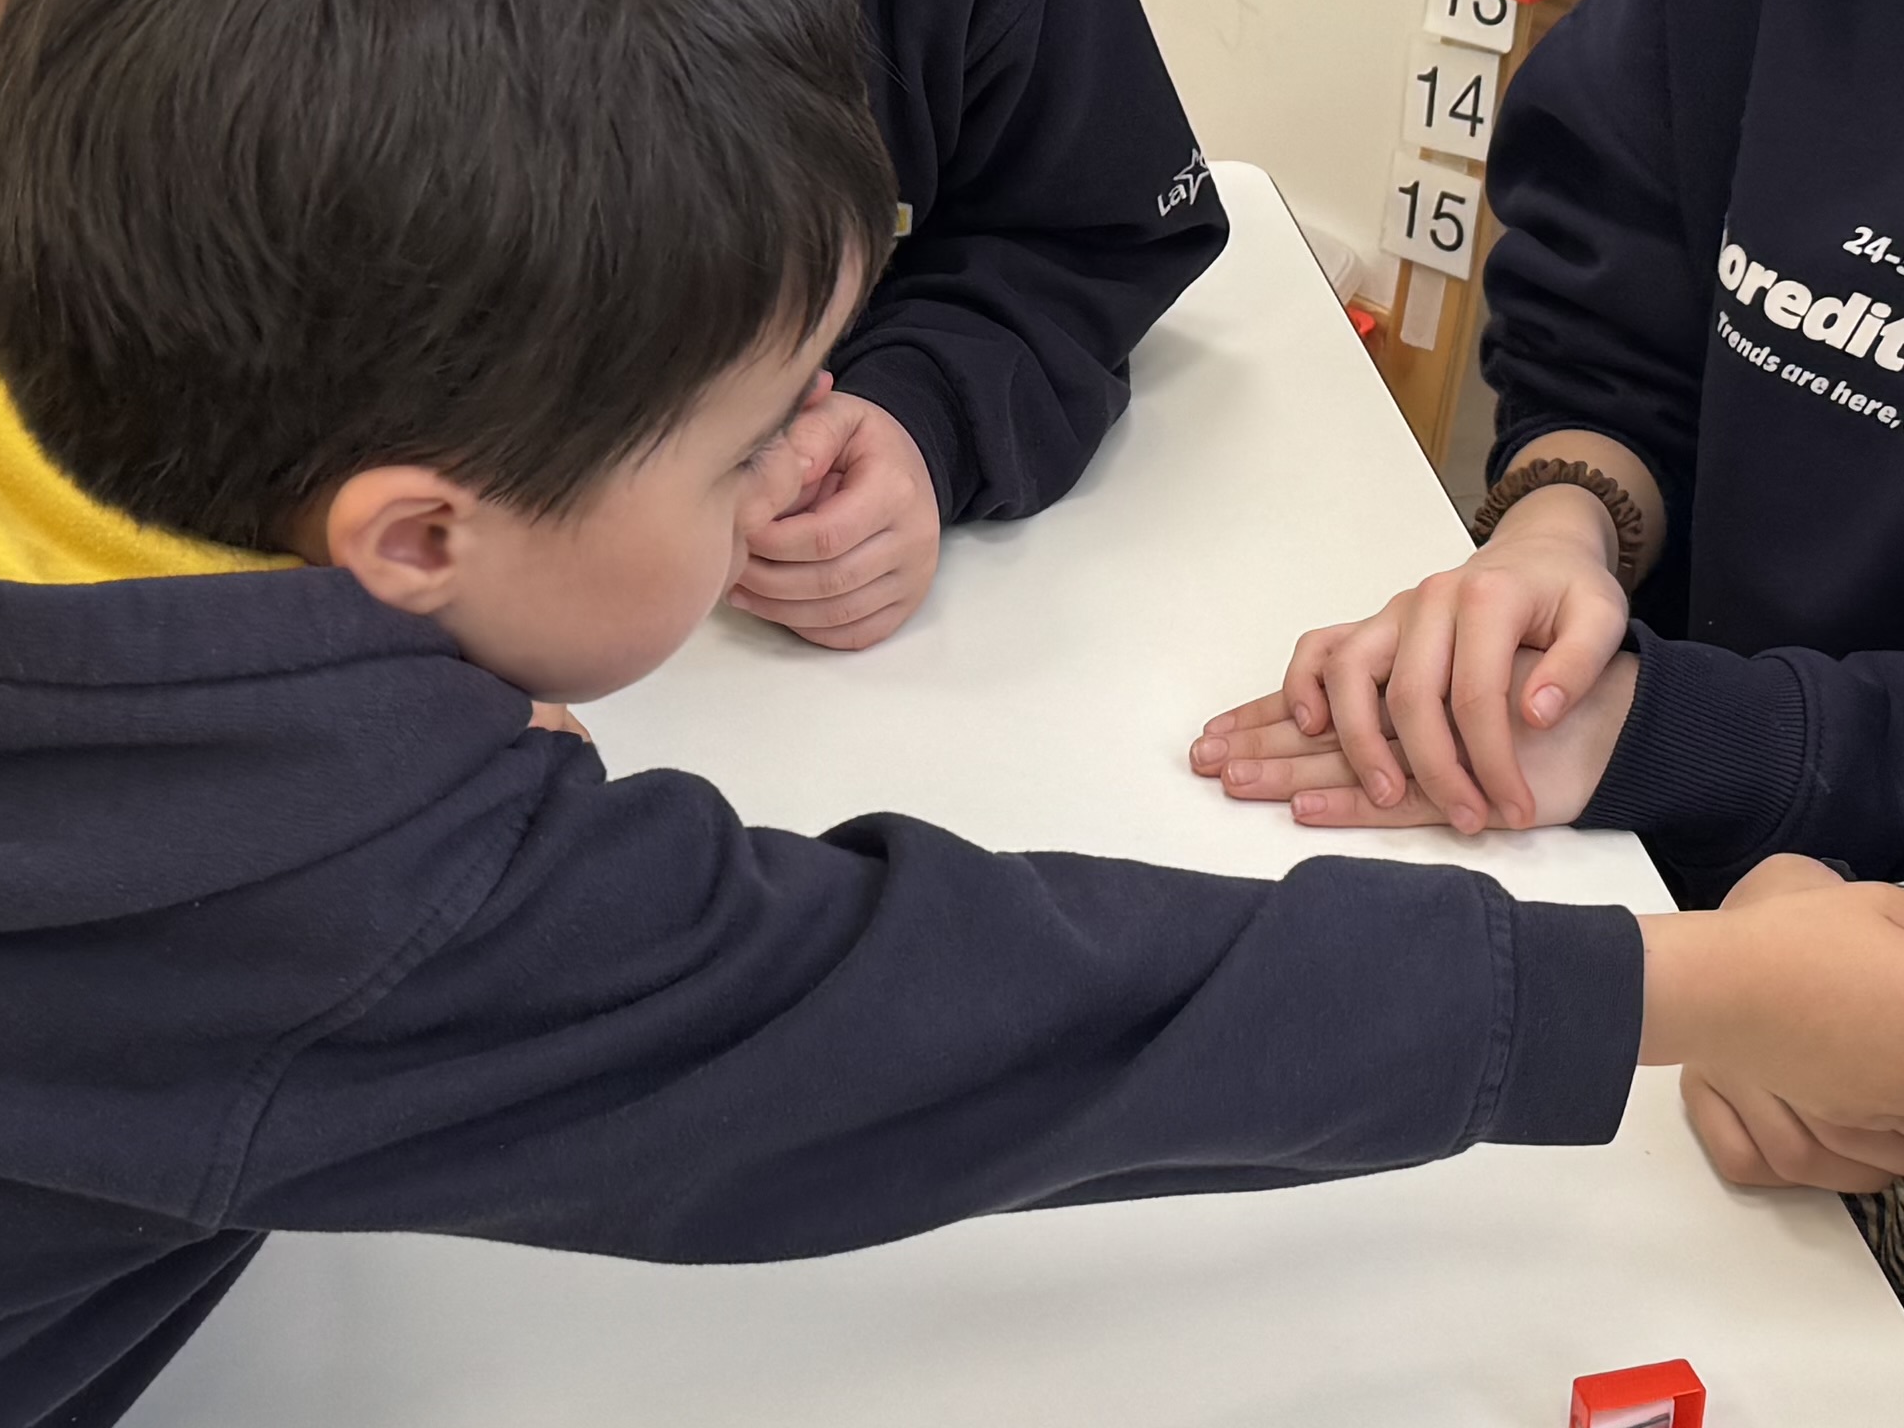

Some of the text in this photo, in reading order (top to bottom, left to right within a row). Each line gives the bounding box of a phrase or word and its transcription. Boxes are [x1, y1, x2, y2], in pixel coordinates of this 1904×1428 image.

[1416, 66, 1485, 137] 14
[1157, 183, 1186, 217] La
[1397, 179, 1467, 252] 15
[1716, 310, 1781, 372] Trends
[1781, 364, 1830, 395] are
[1830, 381, 1901, 429] here,
